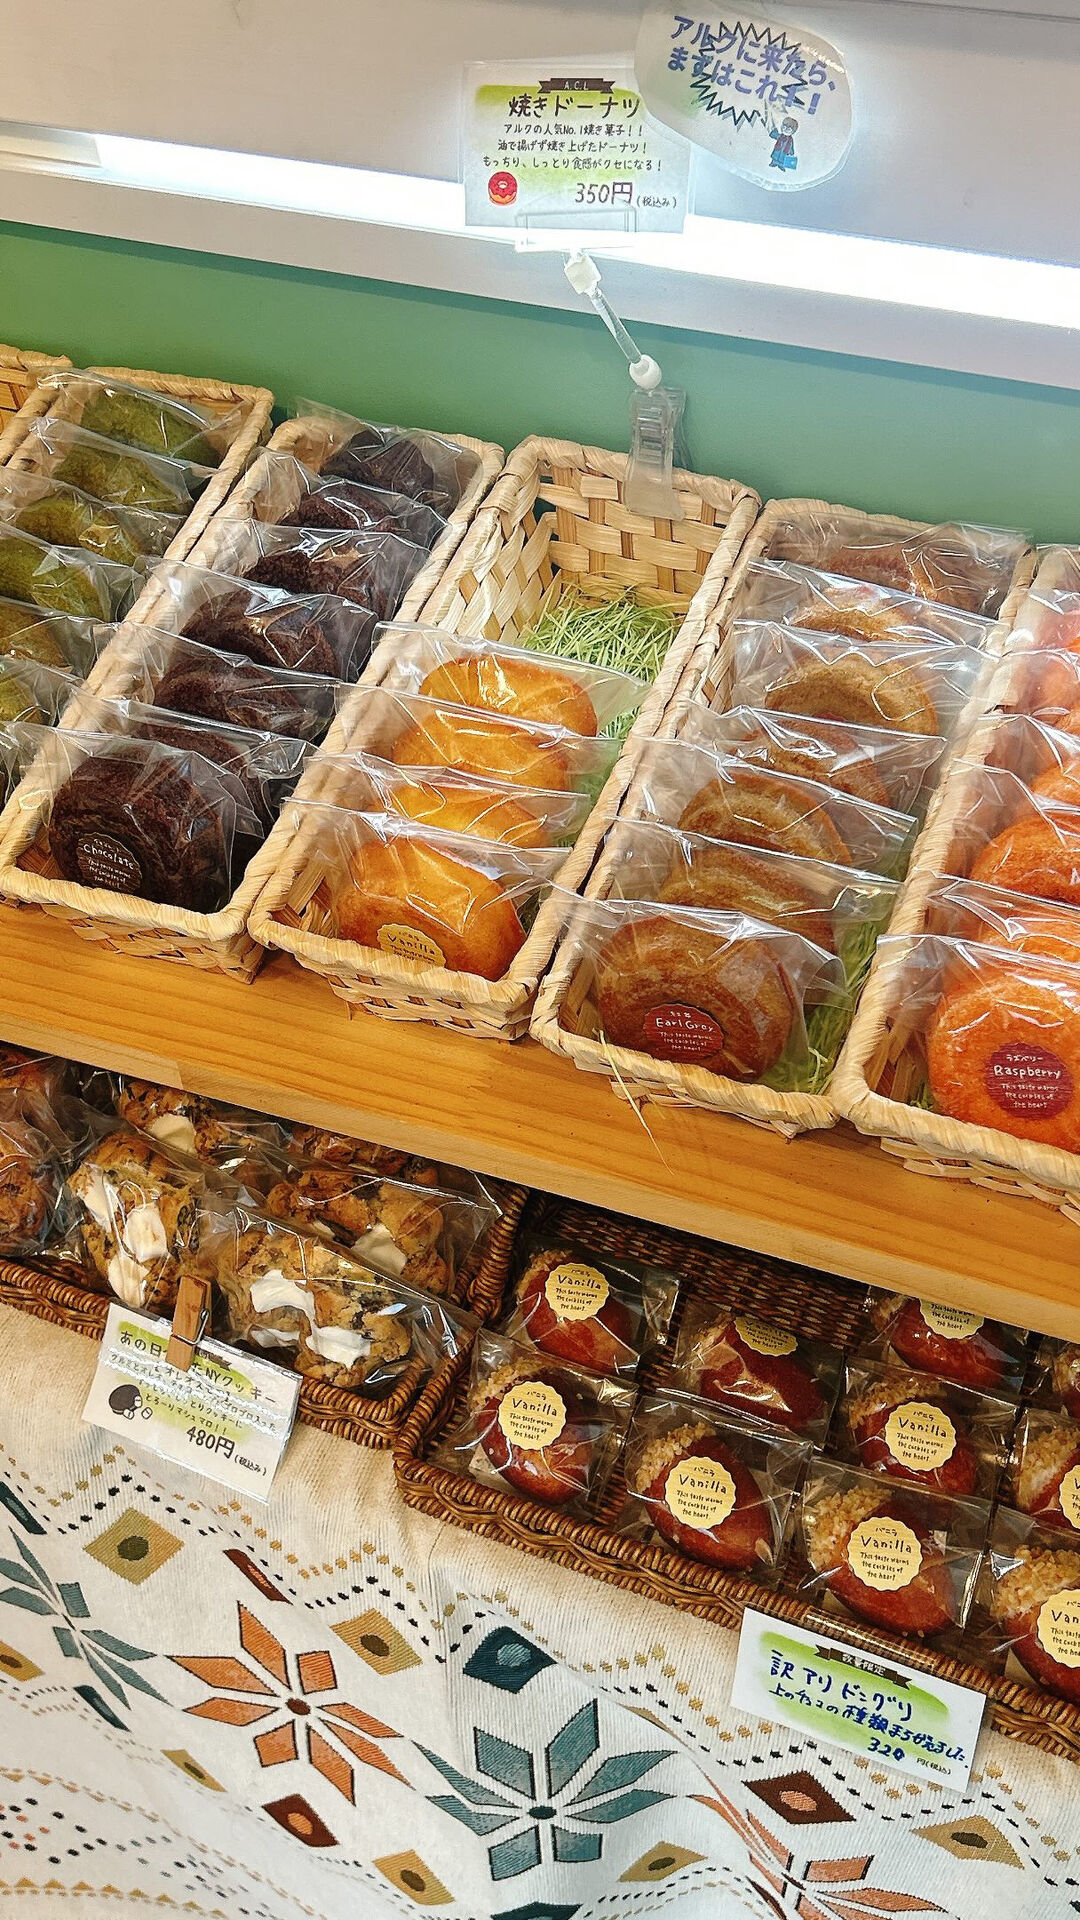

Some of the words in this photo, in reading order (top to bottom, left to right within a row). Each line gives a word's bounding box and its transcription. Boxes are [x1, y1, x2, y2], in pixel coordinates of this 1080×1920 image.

[508, 93, 640, 118] 焼きドーナツ
[575, 182, 632, 204] 350円
[83, 843, 134, 870] Chocolate
[388, 934, 435, 955] Vanilla
[994, 1065, 1061, 1079] Raspberry
[558, 1274, 601, 1289] Vanilla
[512, 1398, 557, 1417] Vanilla
[899, 1417, 947, 1438] Vanilla
[186, 1426, 235, 1458] 480円
[680, 1474, 727, 1494] Vanilla
[861, 1535, 911, 1553] Vanilla
[867, 1737, 905, 1762] 320
